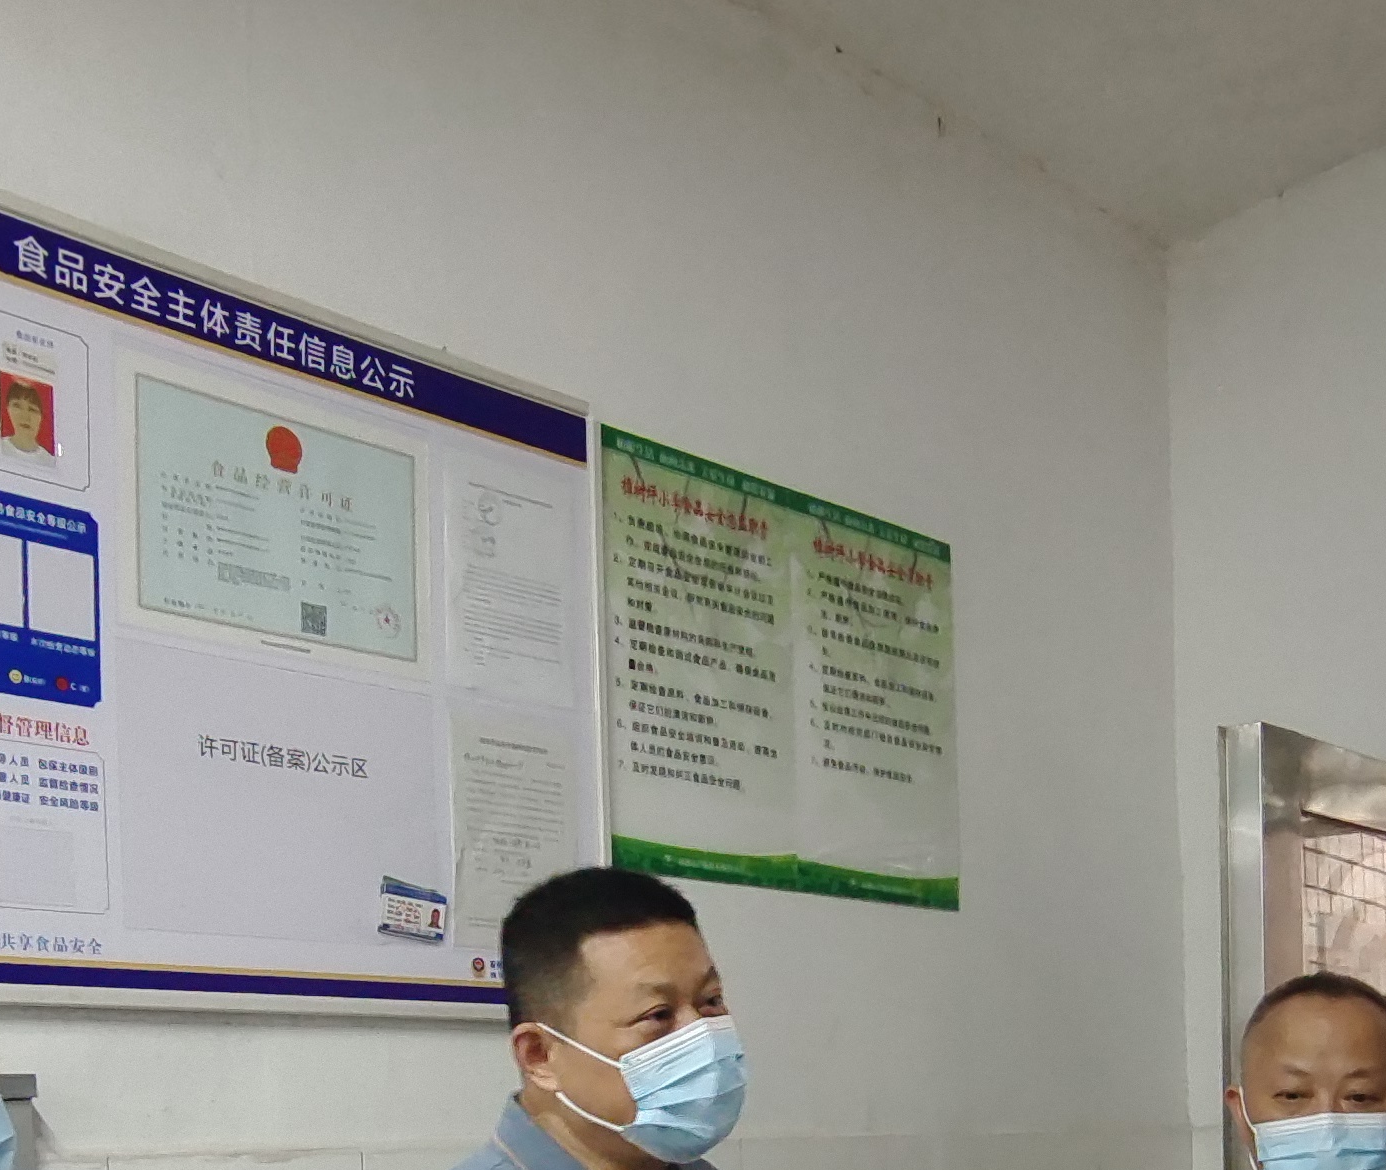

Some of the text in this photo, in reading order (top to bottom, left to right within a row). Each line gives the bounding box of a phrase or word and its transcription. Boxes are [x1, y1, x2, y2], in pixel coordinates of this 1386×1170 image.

[13, 234, 416, 401] 食品安全主体责任信息公示
[197, 734, 369, 779] 许可证(备案)公示区
